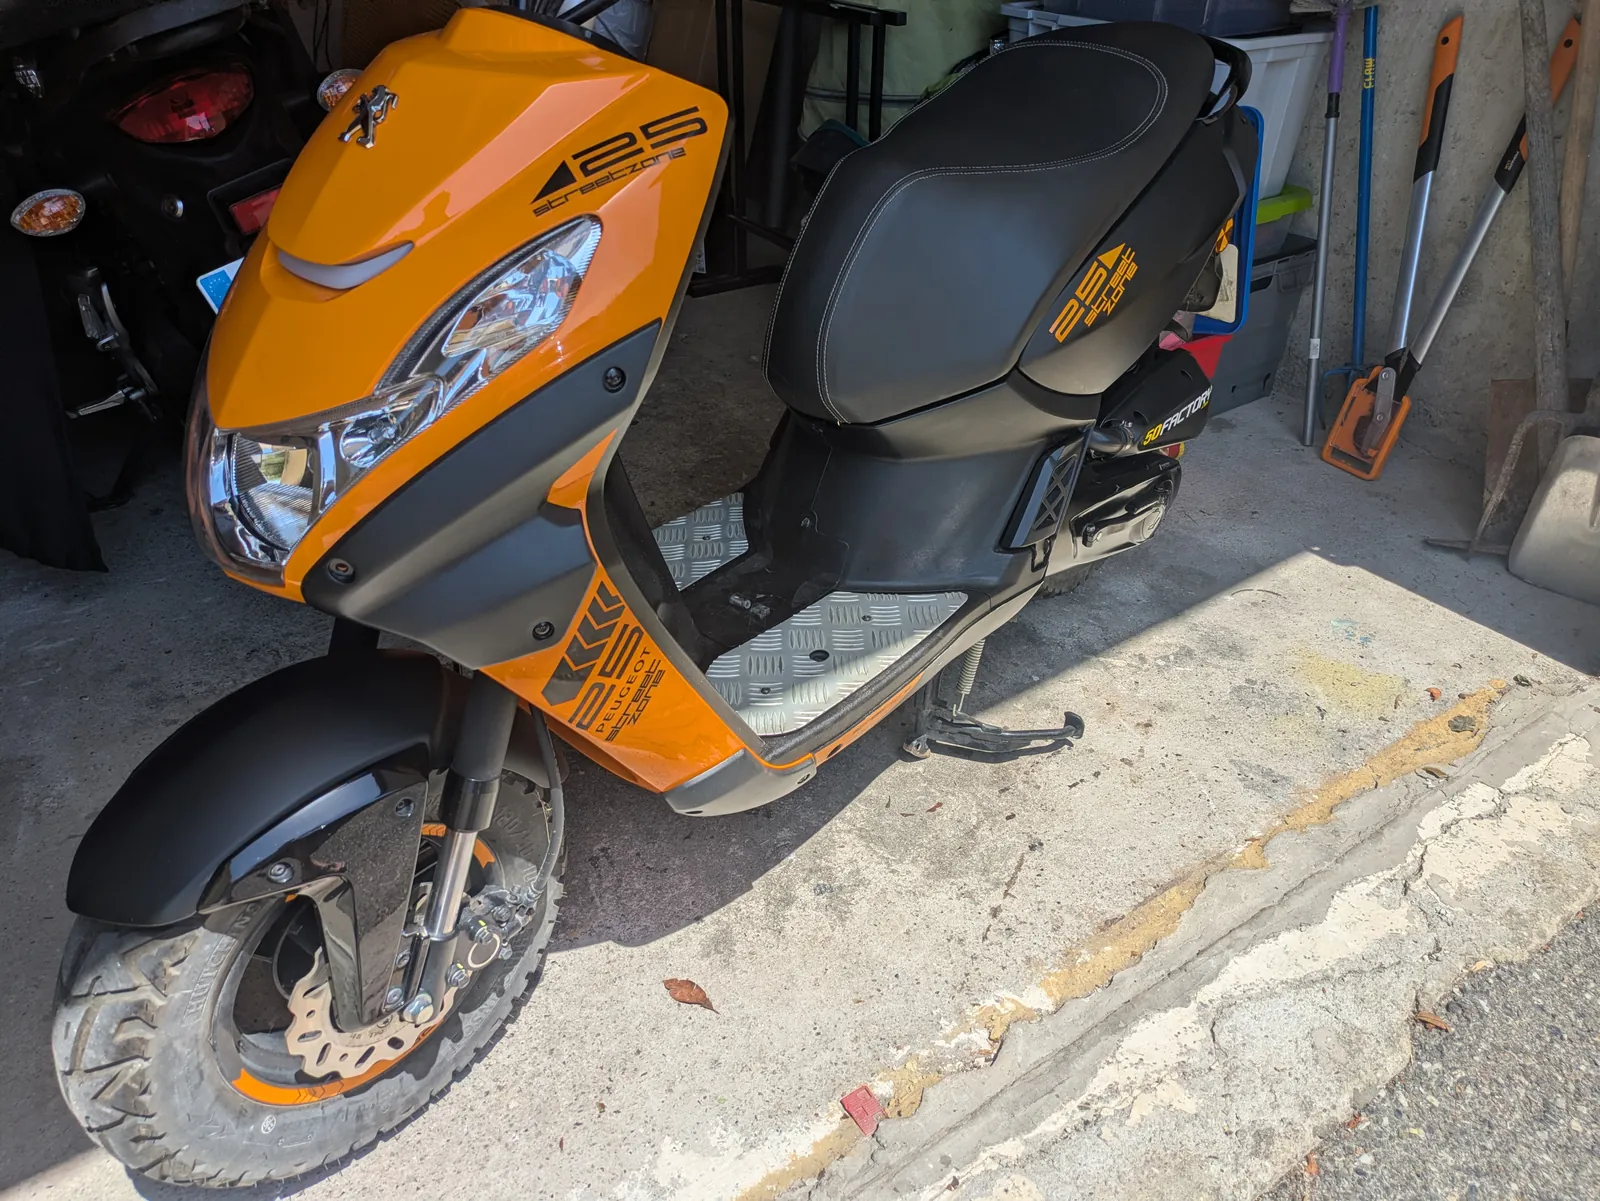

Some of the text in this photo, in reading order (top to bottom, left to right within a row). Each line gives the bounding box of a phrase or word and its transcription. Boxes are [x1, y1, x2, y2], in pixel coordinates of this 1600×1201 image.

[1363, 58, 1374, 88] CLAW
[533, 147, 686, 217] streetzone
[1084, 247, 1135, 327] street
[1103, 262, 1138, 316] zone
[595, 646, 651, 733] PEUGEOT
[604, 658, 661, 742] street
[627, 669, 667, 725] zone
